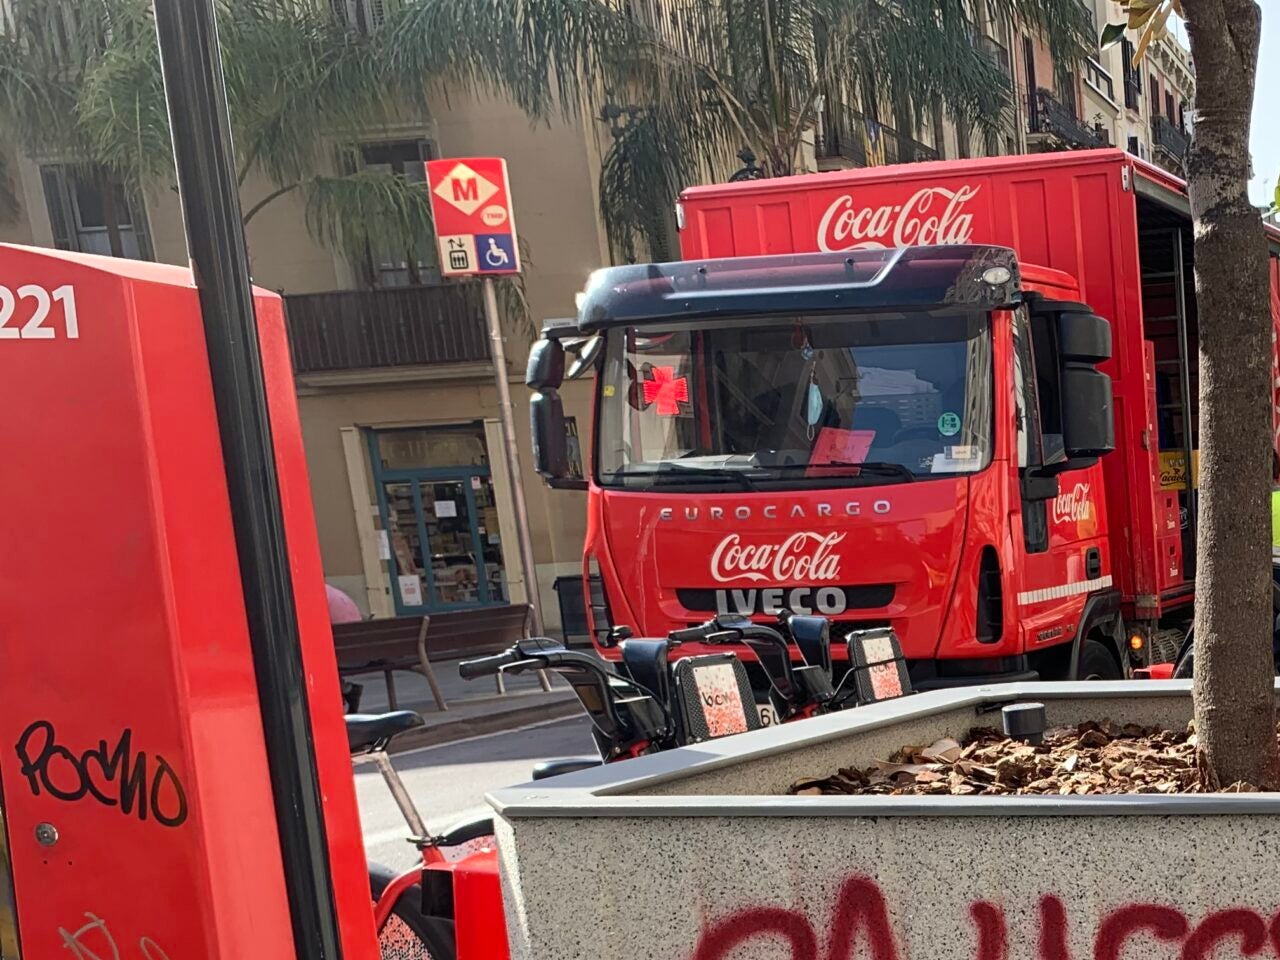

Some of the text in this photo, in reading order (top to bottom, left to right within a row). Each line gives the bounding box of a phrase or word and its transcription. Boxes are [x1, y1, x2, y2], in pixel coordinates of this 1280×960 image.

[451, 178, 479, 201] M
[817, 184, 981, 252] Coca-Cola
[660, 500, 891, 521] EUROCARGO
[710, 531, 848, 582] Coca-Cola
[715, 586, 847, 616] IVECO
